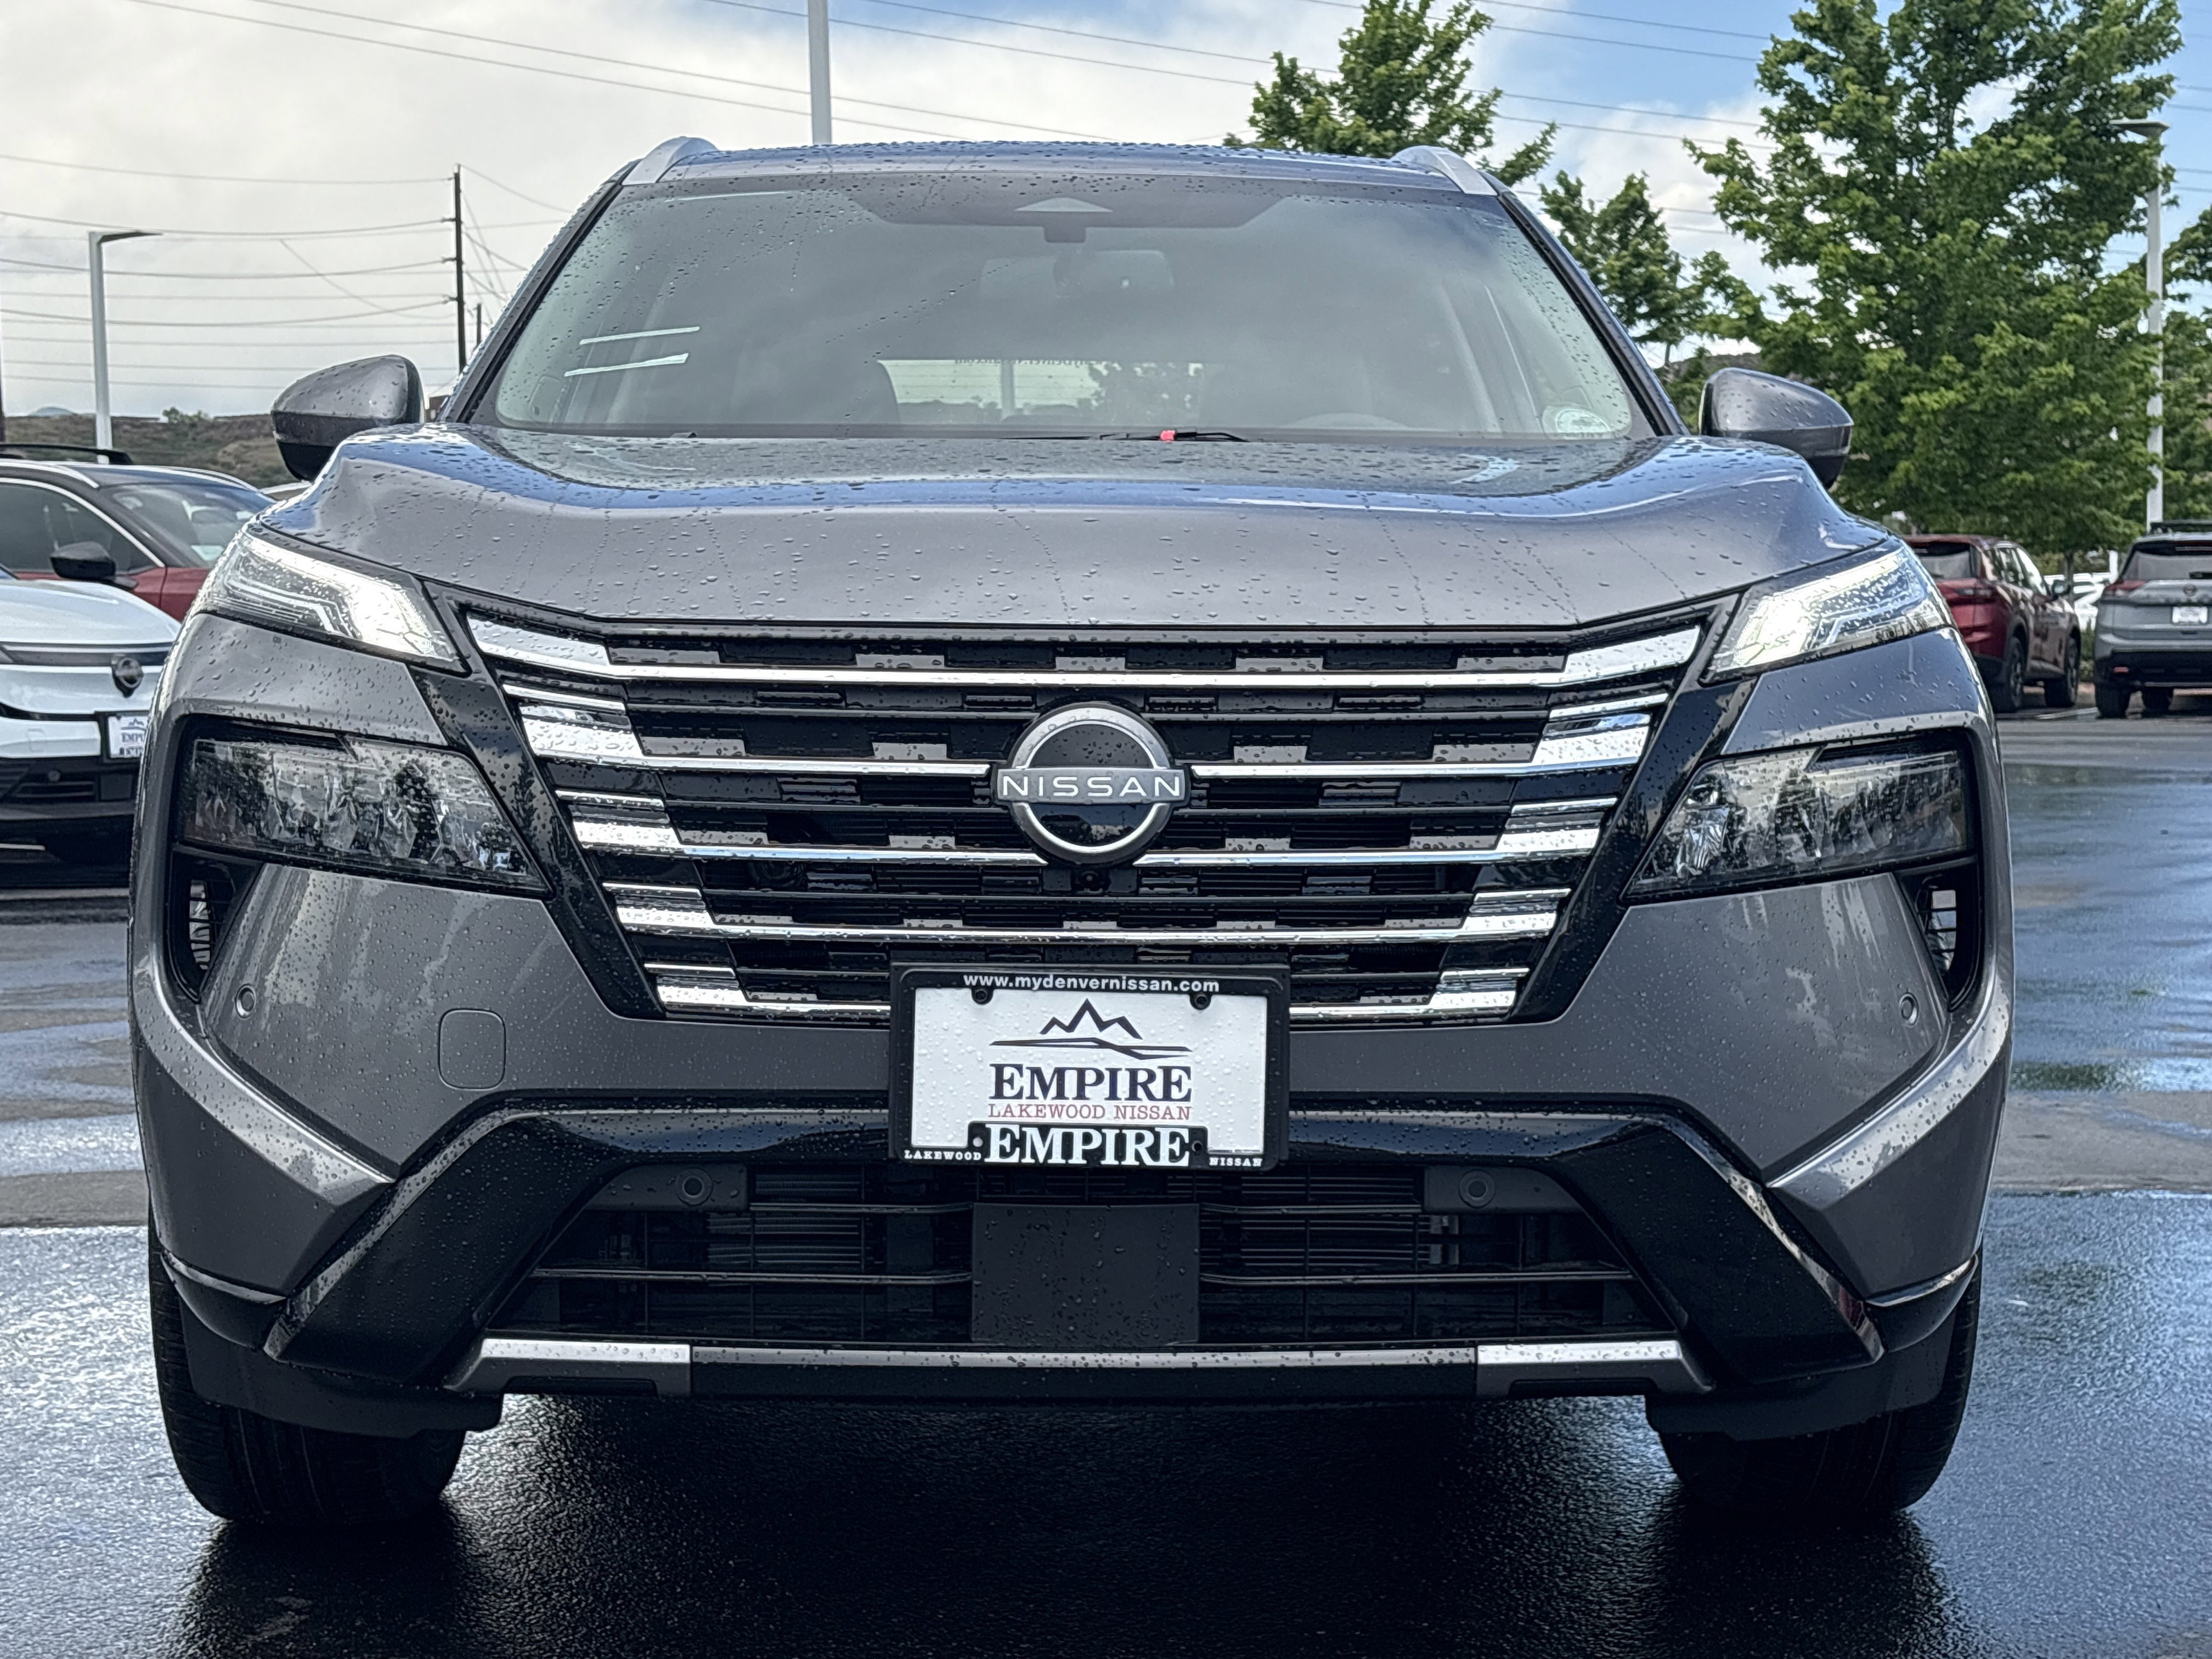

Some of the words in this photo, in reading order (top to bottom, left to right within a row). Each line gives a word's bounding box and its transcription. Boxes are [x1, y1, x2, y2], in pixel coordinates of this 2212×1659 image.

[1002, 776, 1180, 797] NISSAN
[963, 974, 1219, 992] www.mydenvernissan.com
[989, 1063, 1192, 1103] EMPIRE
[988, 1103, 1106, 1119] LAKEWOOD
[1114, 1105, 1192, 1120] NISSAN
[904, 1149, 982, 1161] LAKEWOOD
[984, 1123, 1190, 1167] EMPIRE
[1209, 1156, 1263, 1167] NISSAN
